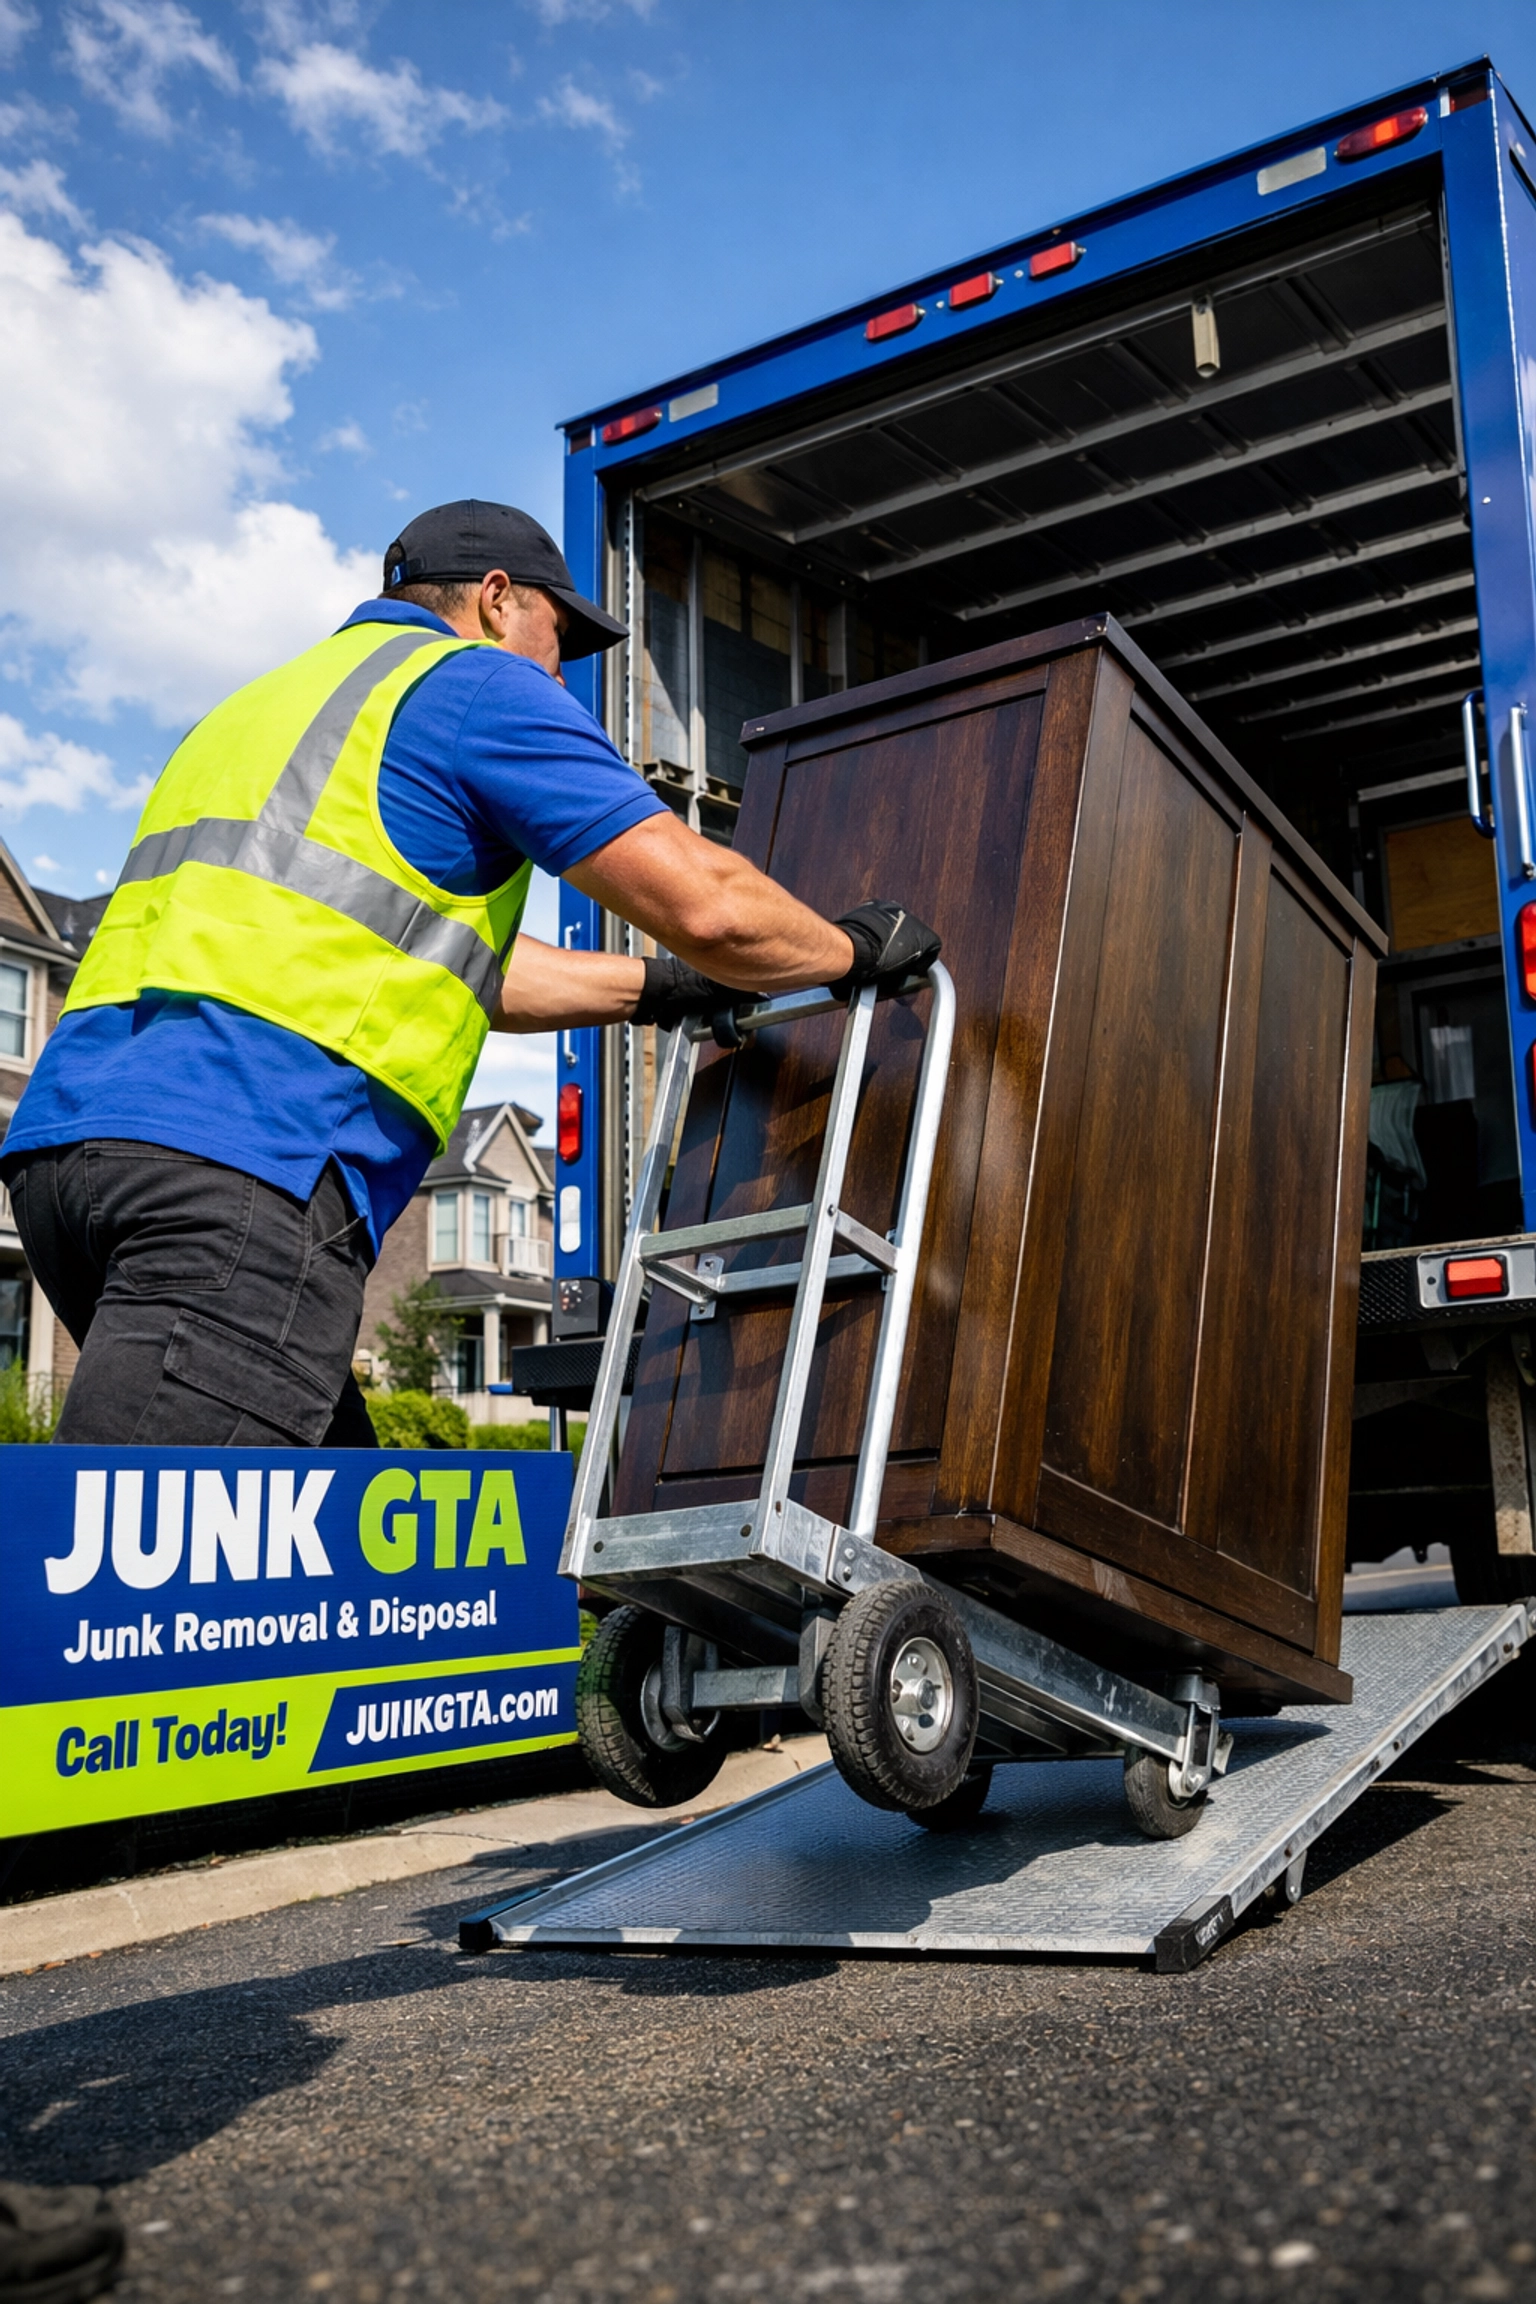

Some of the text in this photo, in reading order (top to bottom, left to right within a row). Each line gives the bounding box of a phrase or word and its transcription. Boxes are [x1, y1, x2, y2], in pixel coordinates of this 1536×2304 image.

[44, 1468, 527, 1595] JUNK GTA
[63, 1589, 497, 1664] Junk Removal & Disposal
[55, 1701, 288, 1778] Call Today!
